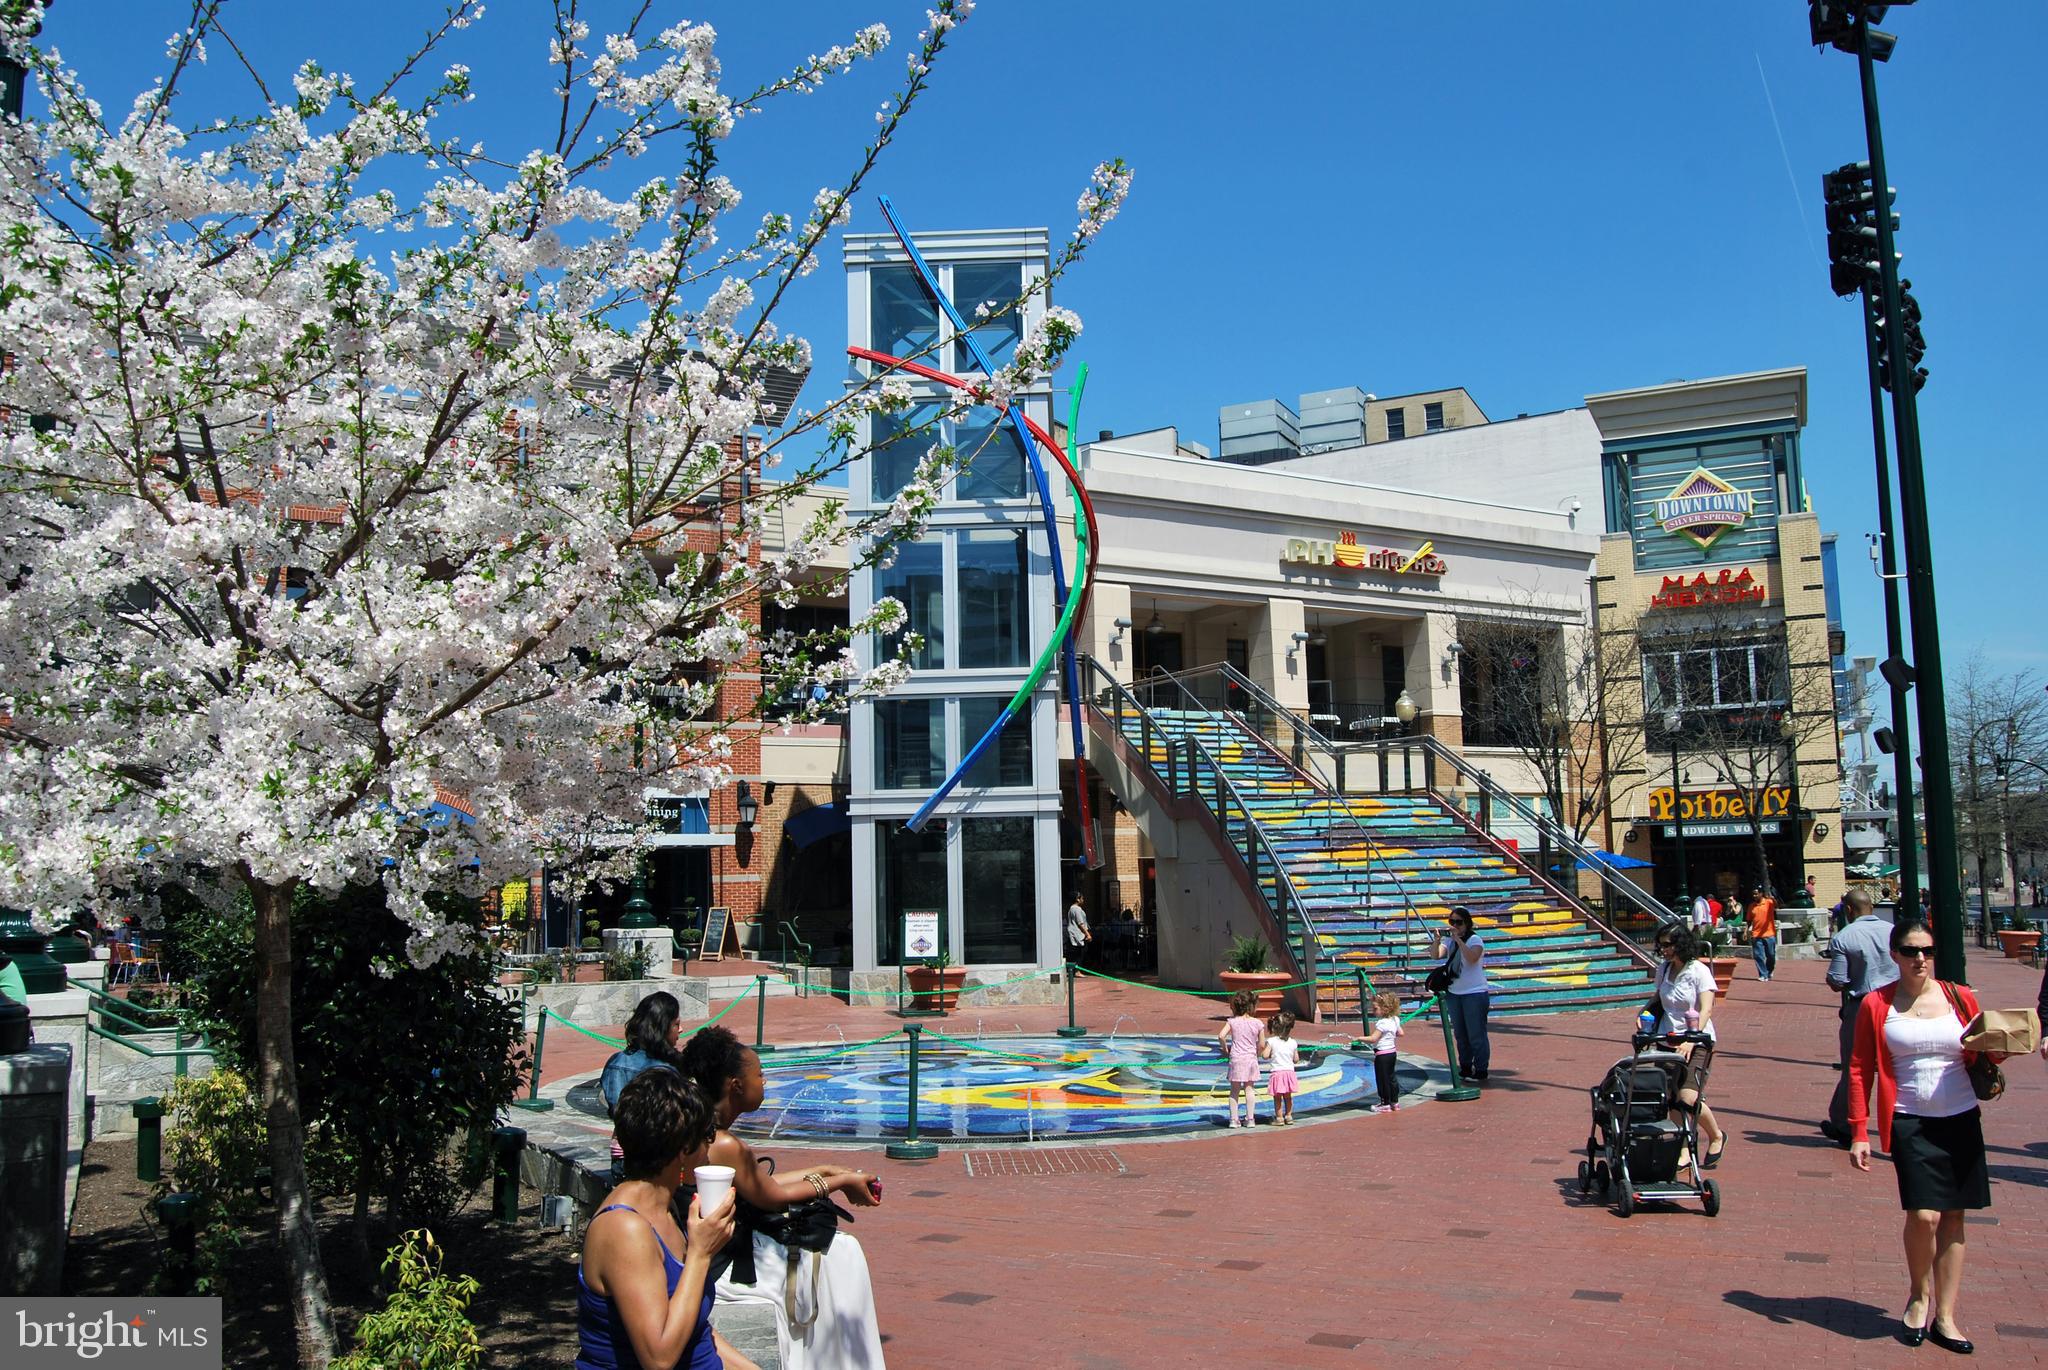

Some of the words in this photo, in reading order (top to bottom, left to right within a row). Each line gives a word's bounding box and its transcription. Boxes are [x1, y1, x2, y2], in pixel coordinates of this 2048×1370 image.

[1658, 493, 1747, 520] DOWNTOWN
[1669, 515, 1701, 528] SILVER
[1703, 513, 1738, 522] SPRING
[1667, 825, 1728, 837] SNDWICH
[1734, 823, 1777, 834] WOKS
